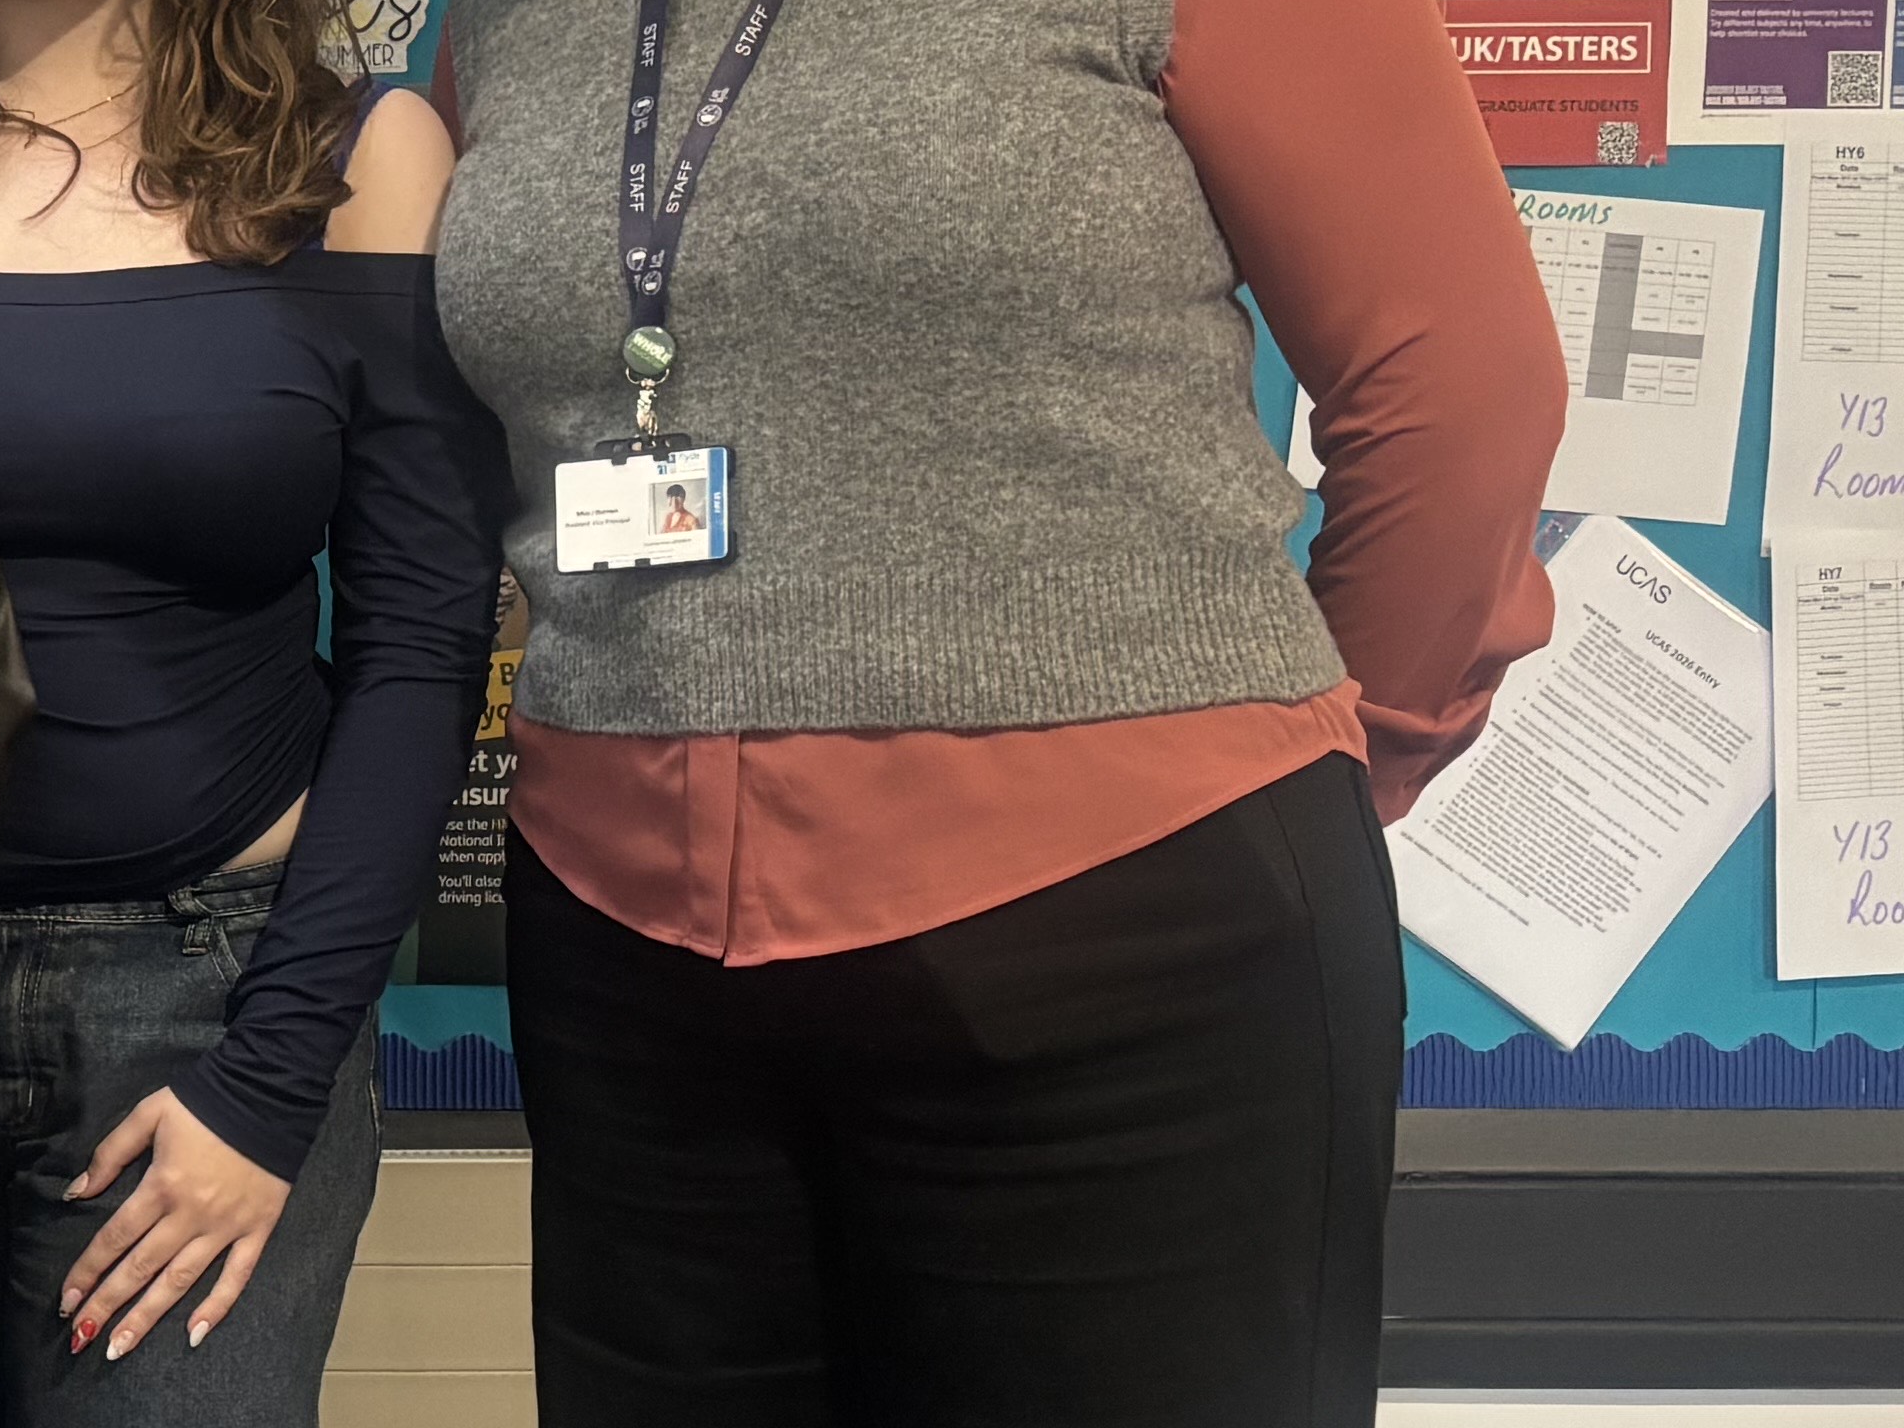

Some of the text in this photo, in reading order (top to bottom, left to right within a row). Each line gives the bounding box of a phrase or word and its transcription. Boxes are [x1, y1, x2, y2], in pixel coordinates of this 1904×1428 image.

[640, 22, 658, 68] STAFF
[735, 3, 768, 56] STAFF
[1559, 100, 1639, 113] STUDENTS
[1835, 145, 1866, 160] HY6
[629, 162, 646, 213] STAFF
[666, 159, 693, 214] STAFF
[1840, 391, 1889, 439] Y13
[1615, 553, 1672, 605] UCAS
[1644, 629, 1672, 655] UCAS
[1693, 663, 1722, 690] Entry
[439, 834, 494, 847] National
[467, 818, 489, 831] the
[1832, 820, 1893, 863] Y13
[438, 849, 475, 863] when
[438, 875, 472, 888] You'll
[438, 891, 482, 907] driving
